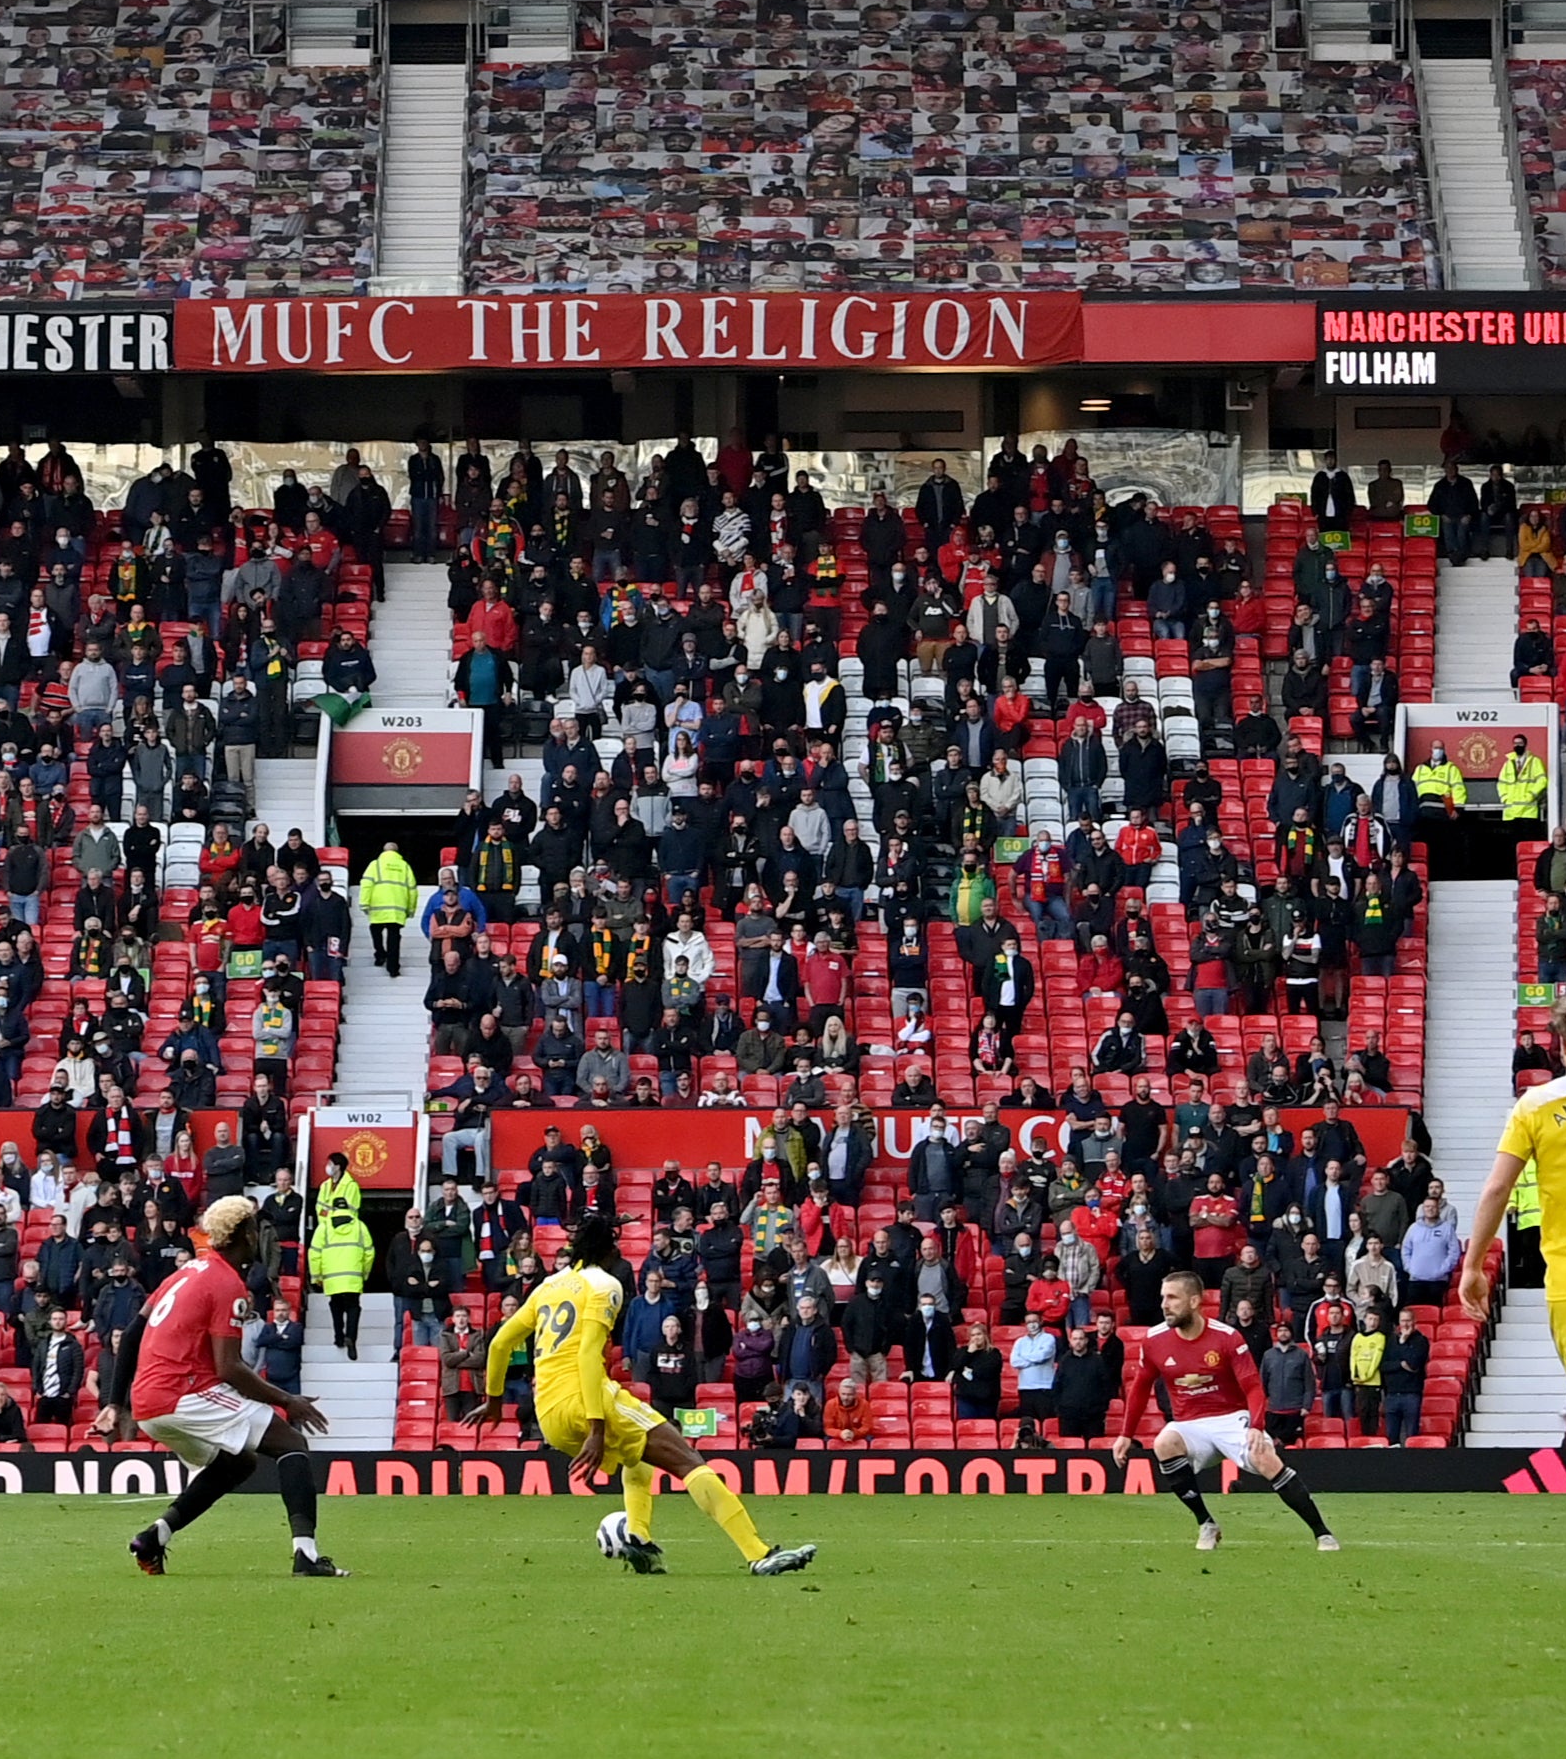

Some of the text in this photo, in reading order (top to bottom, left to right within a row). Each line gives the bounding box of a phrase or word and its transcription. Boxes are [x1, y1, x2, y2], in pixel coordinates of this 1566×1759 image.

[210, 296, 1030, 368] MUFC THE RELIGION
[1323, 311, 1516, 345] MANCHESTER
[1325, 351, 1436, 385] FULHAM
[1413, 516, 1431, 526] GO
[381, 716, 422, 727] W203
[1457, 711, 1498, 721] W202
[1004, 839, 1022, 851] GO
[236, 953, 255, 966] GO
[1527, 985, 1544, 997] GO
[347, 1112, 382, 1124] W102
[148, 1277, 188, 1328] 6
[534, 1300, 578, 1358] 29
[685, 1410, 706, 1425] GO
